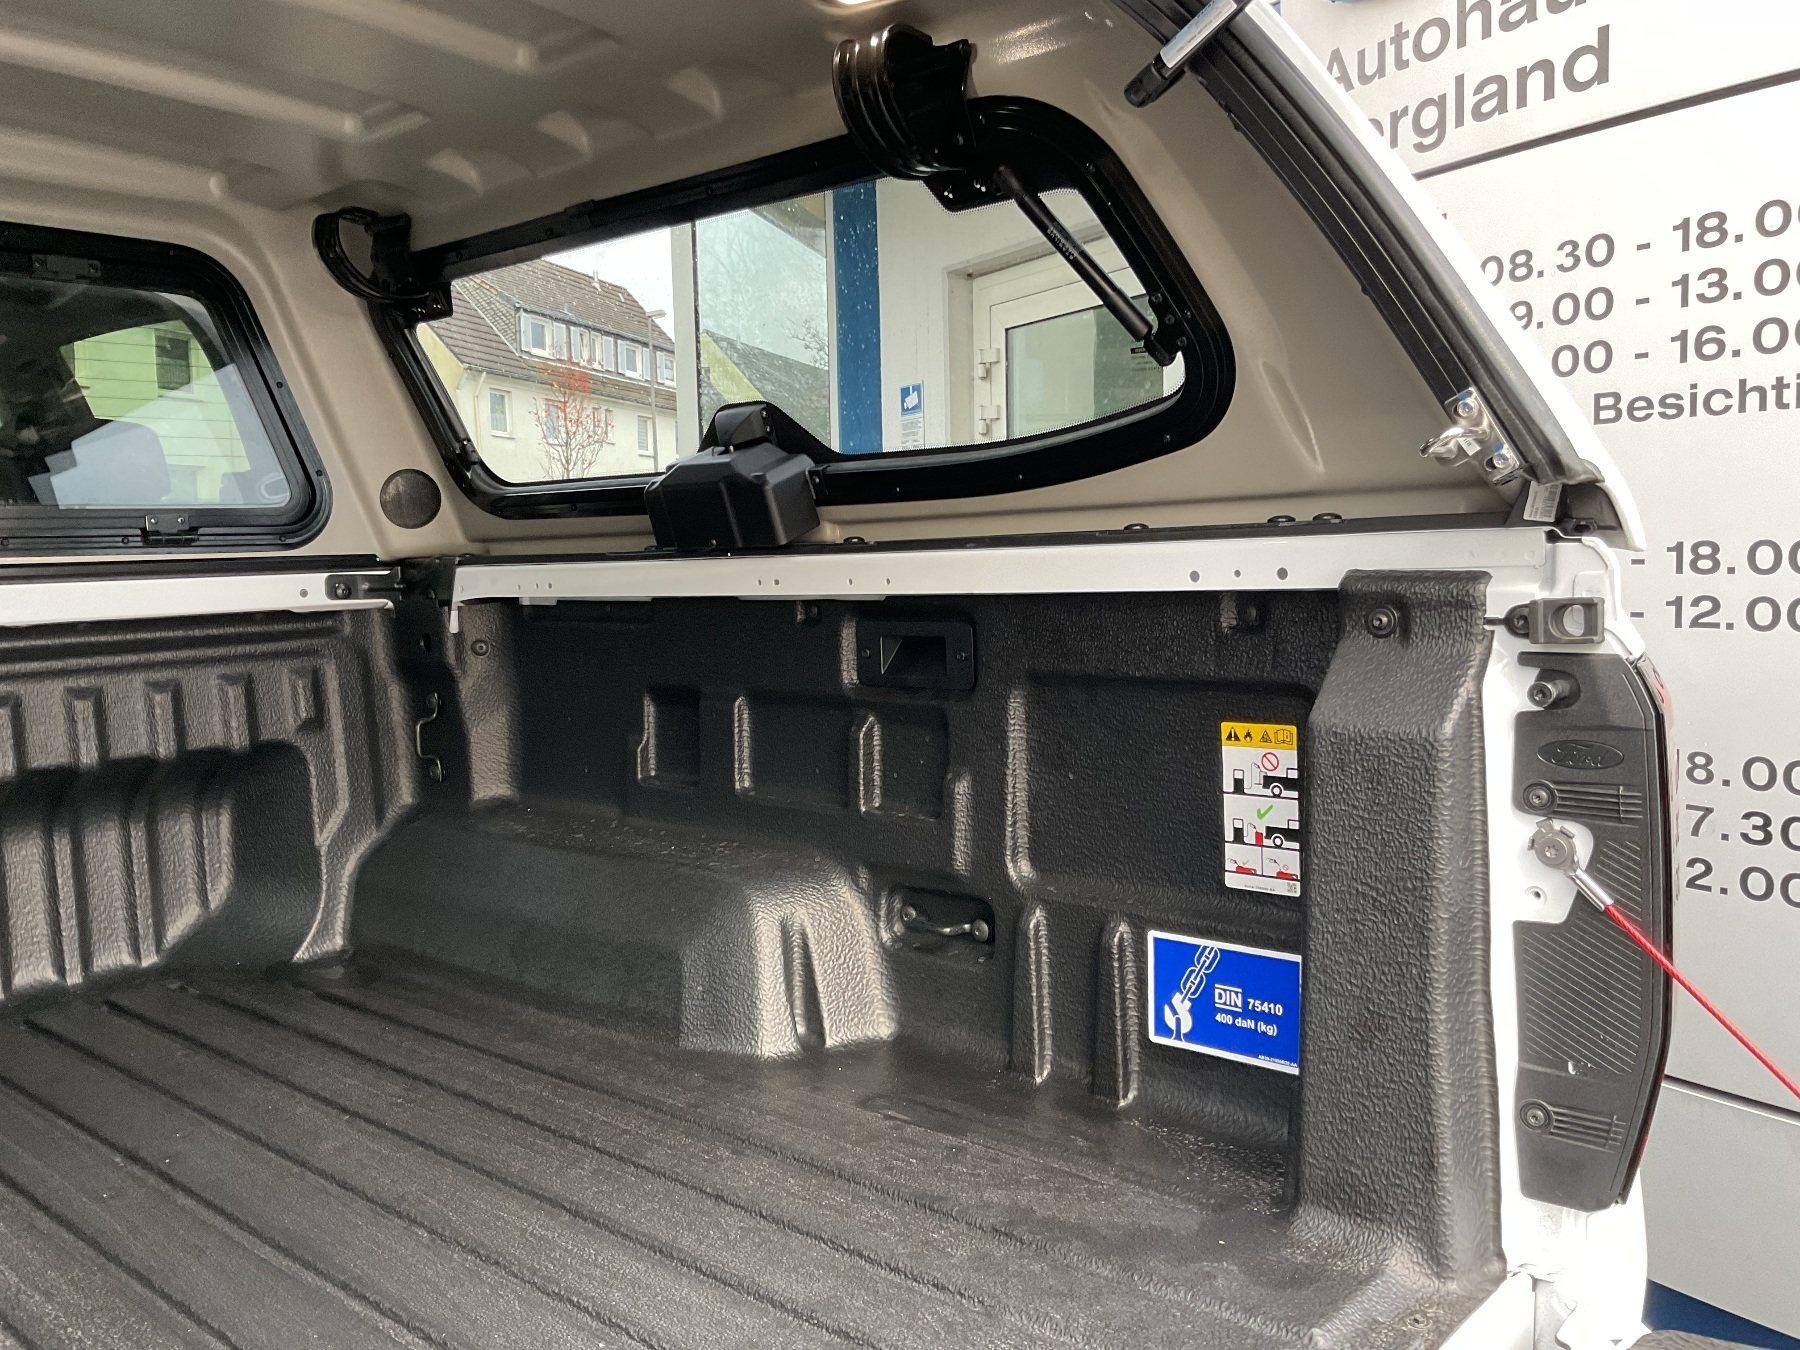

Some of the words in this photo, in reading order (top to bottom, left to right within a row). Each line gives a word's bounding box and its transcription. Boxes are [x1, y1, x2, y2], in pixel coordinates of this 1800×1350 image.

[1368, 24, 1610, 153] rgland
[1672, 199, 1800, 253] 18.0
[1509, 287, 1614, 331] 9.00
[1671, 258, 1800, 308] 13.0
[1670, 317, 1800, 364] 16.0
[1214, 986, 1243, 1008] DIN
[1247, 999, 1283, 1016] 75410
[1215, 1012, 1233, 1025] 400
[1234, 1018, 1255, 1030] daN
[1257, 1022, 1278, 1037] (kg)
